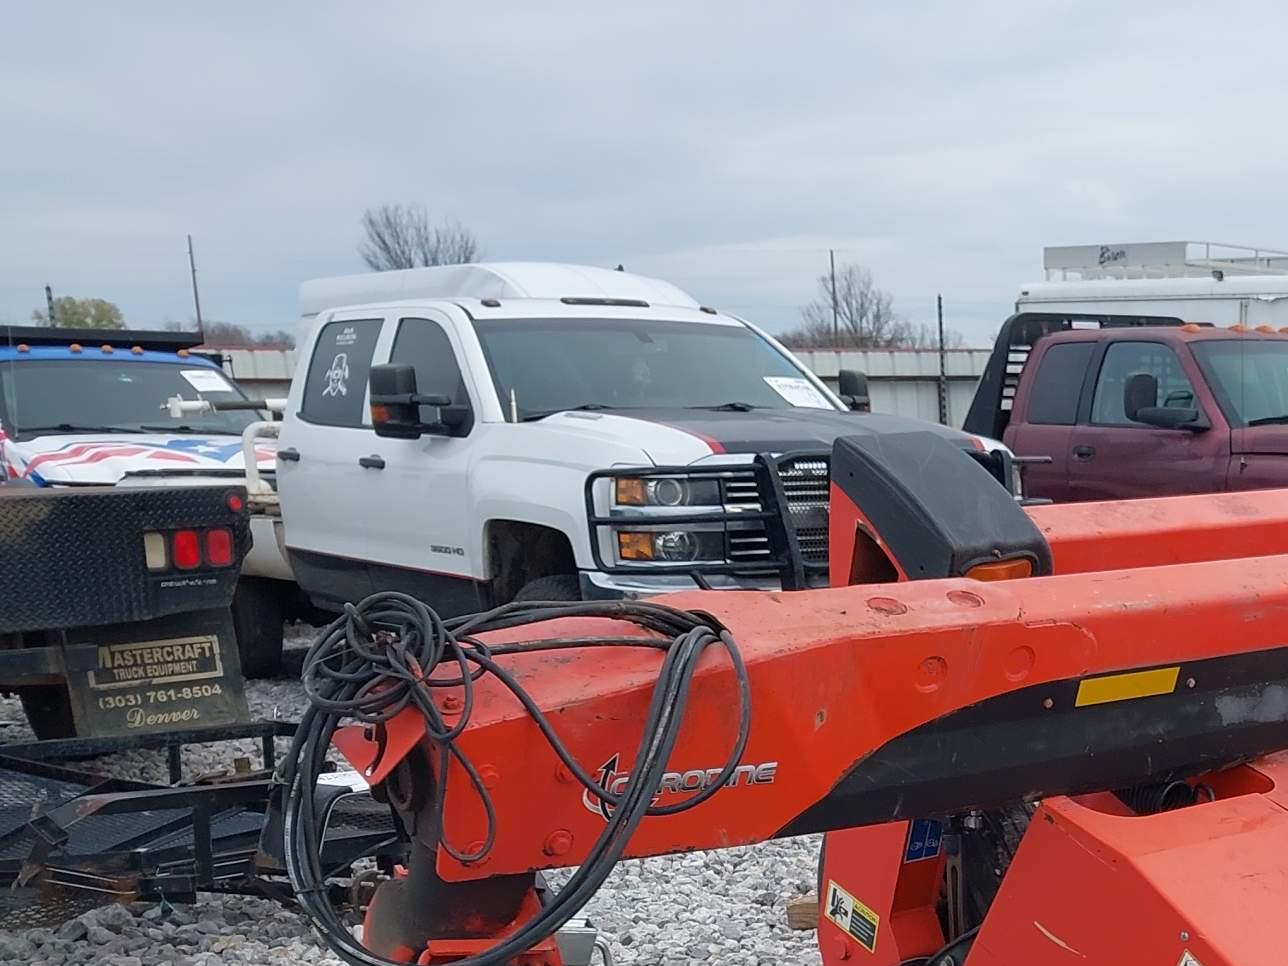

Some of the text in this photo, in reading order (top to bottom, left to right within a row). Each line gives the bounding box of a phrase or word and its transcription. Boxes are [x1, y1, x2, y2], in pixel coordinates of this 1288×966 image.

[113, 660, 198, 681] TRUCK EQUIPMENT
[98, 683, 222, 709] (303) 761-8504
[127, 706, 199, 728] Denver
